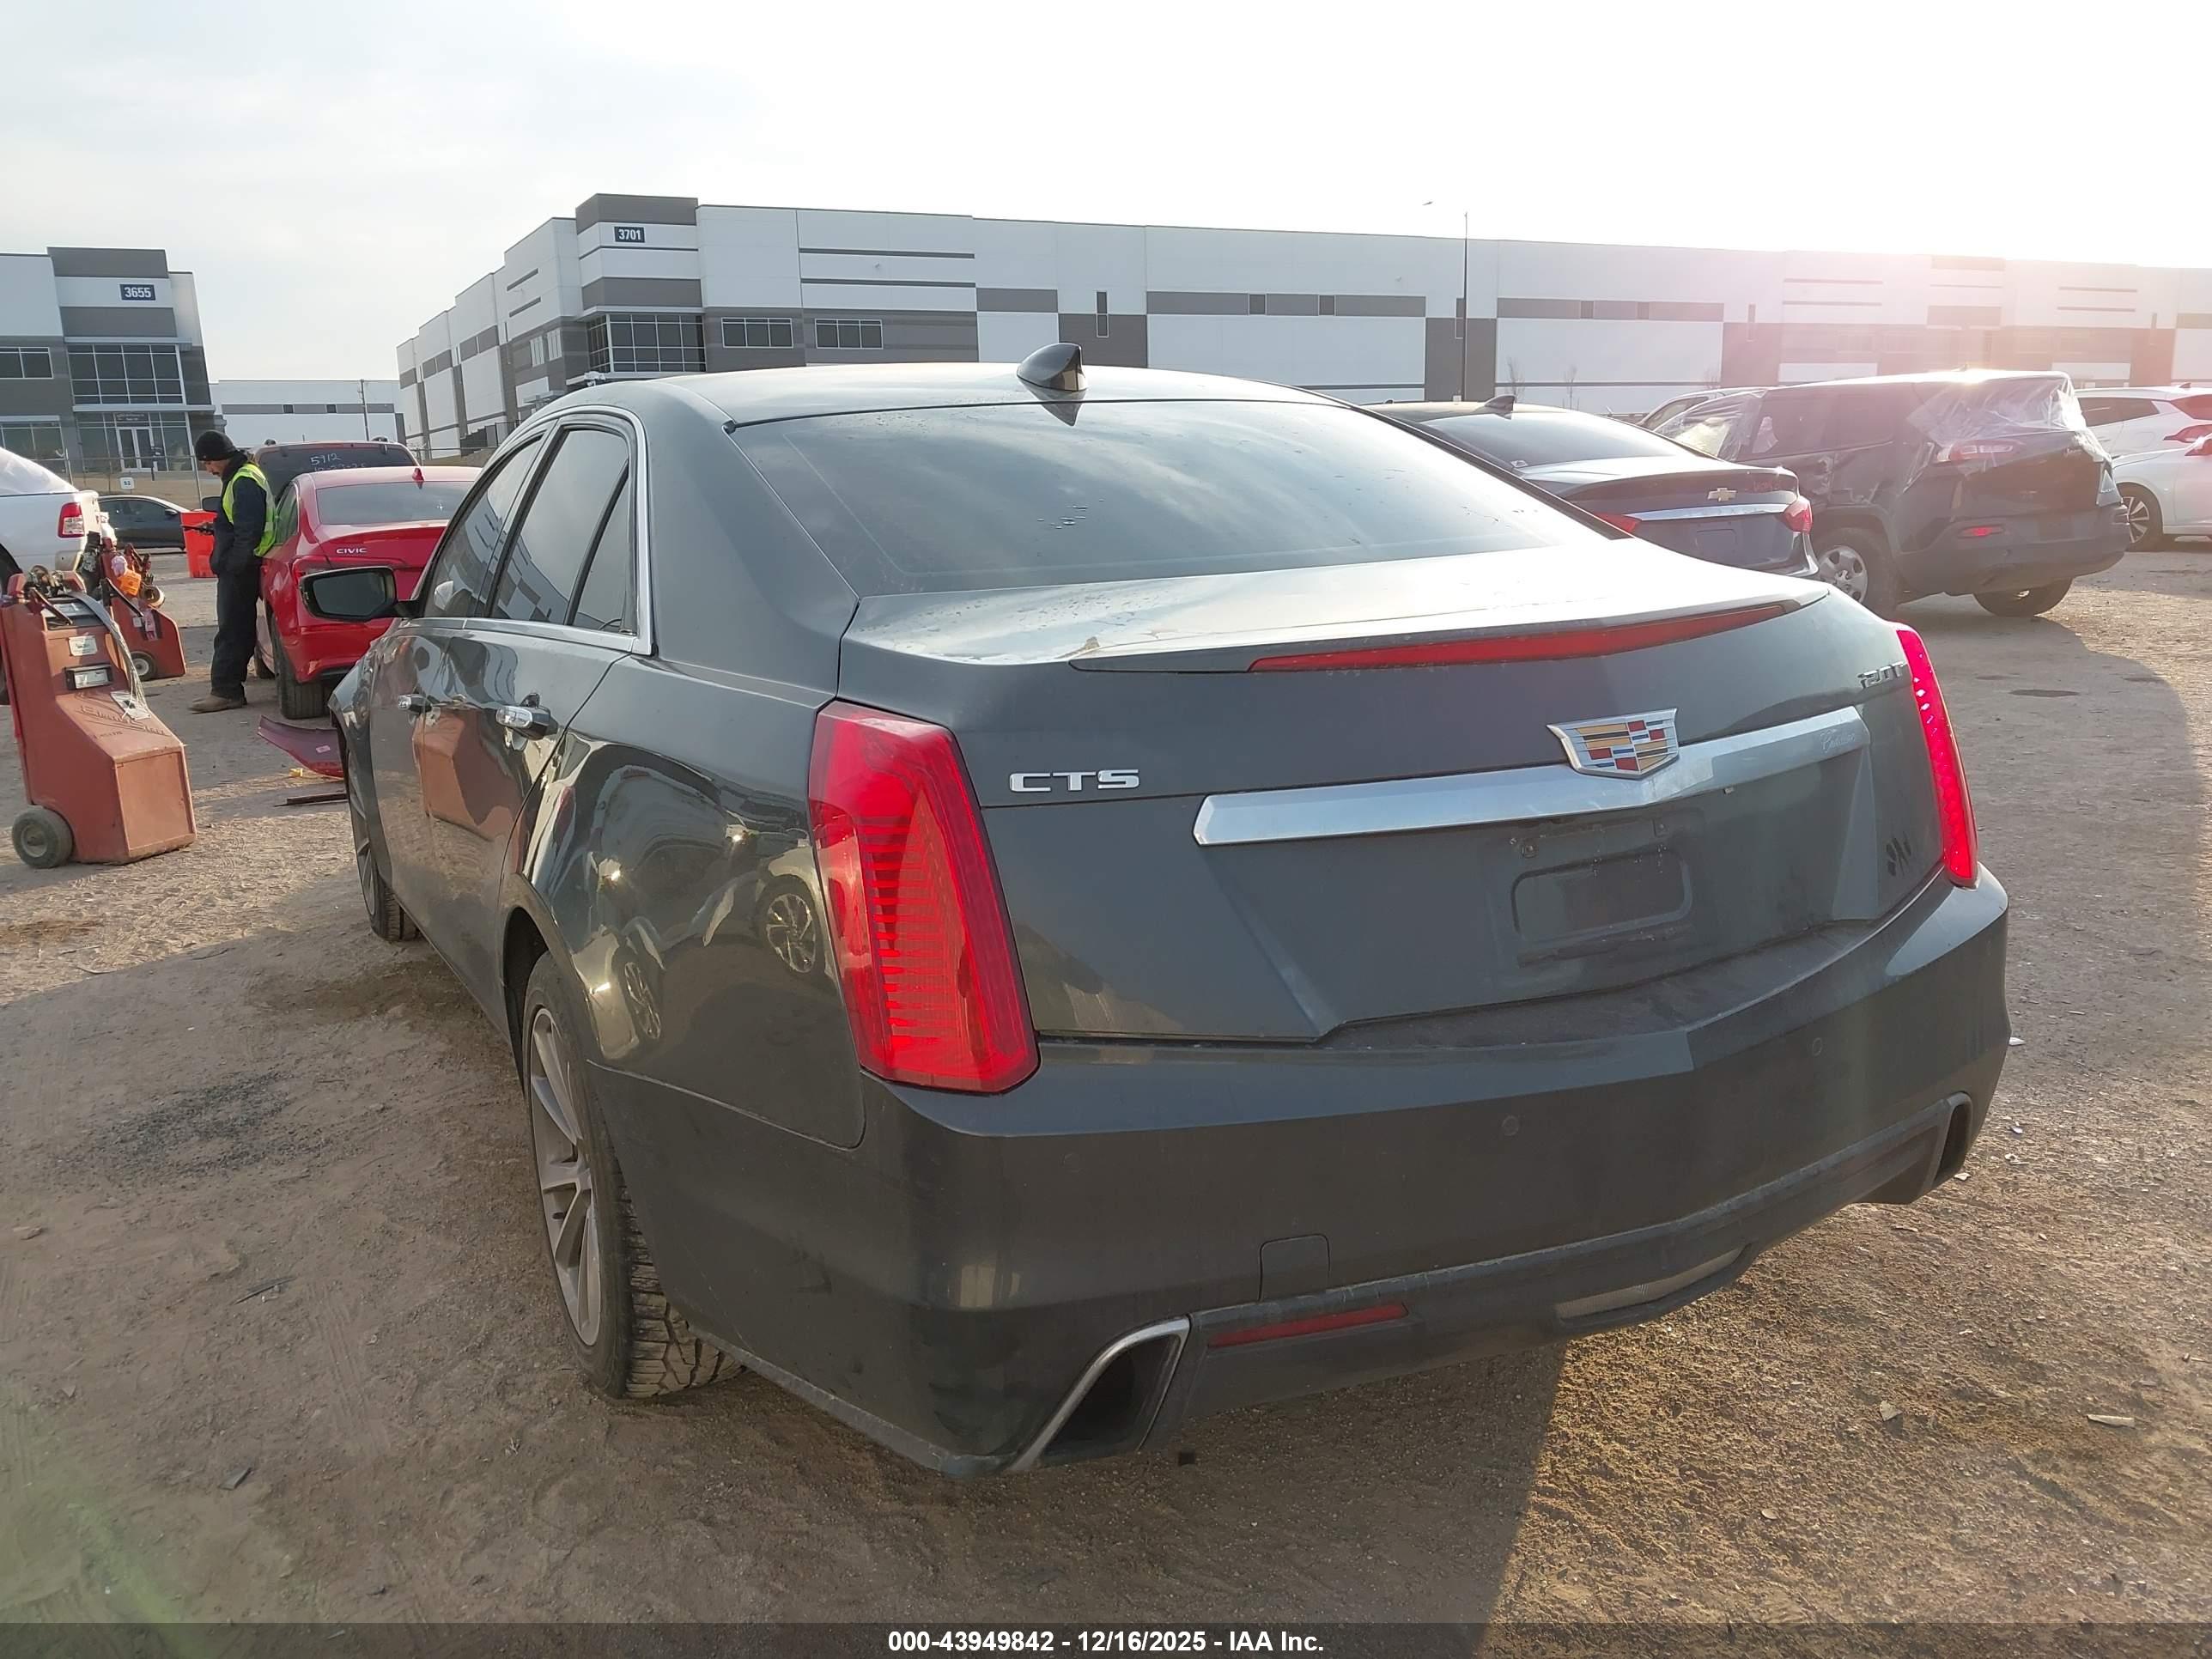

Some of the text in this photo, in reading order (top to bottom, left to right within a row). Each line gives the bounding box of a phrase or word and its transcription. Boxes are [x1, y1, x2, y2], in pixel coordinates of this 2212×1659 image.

[618, 228, 641, 240] 3701
[124, 287, 151, 298] 3655
[1009, 769, 1140, 792] CTS
